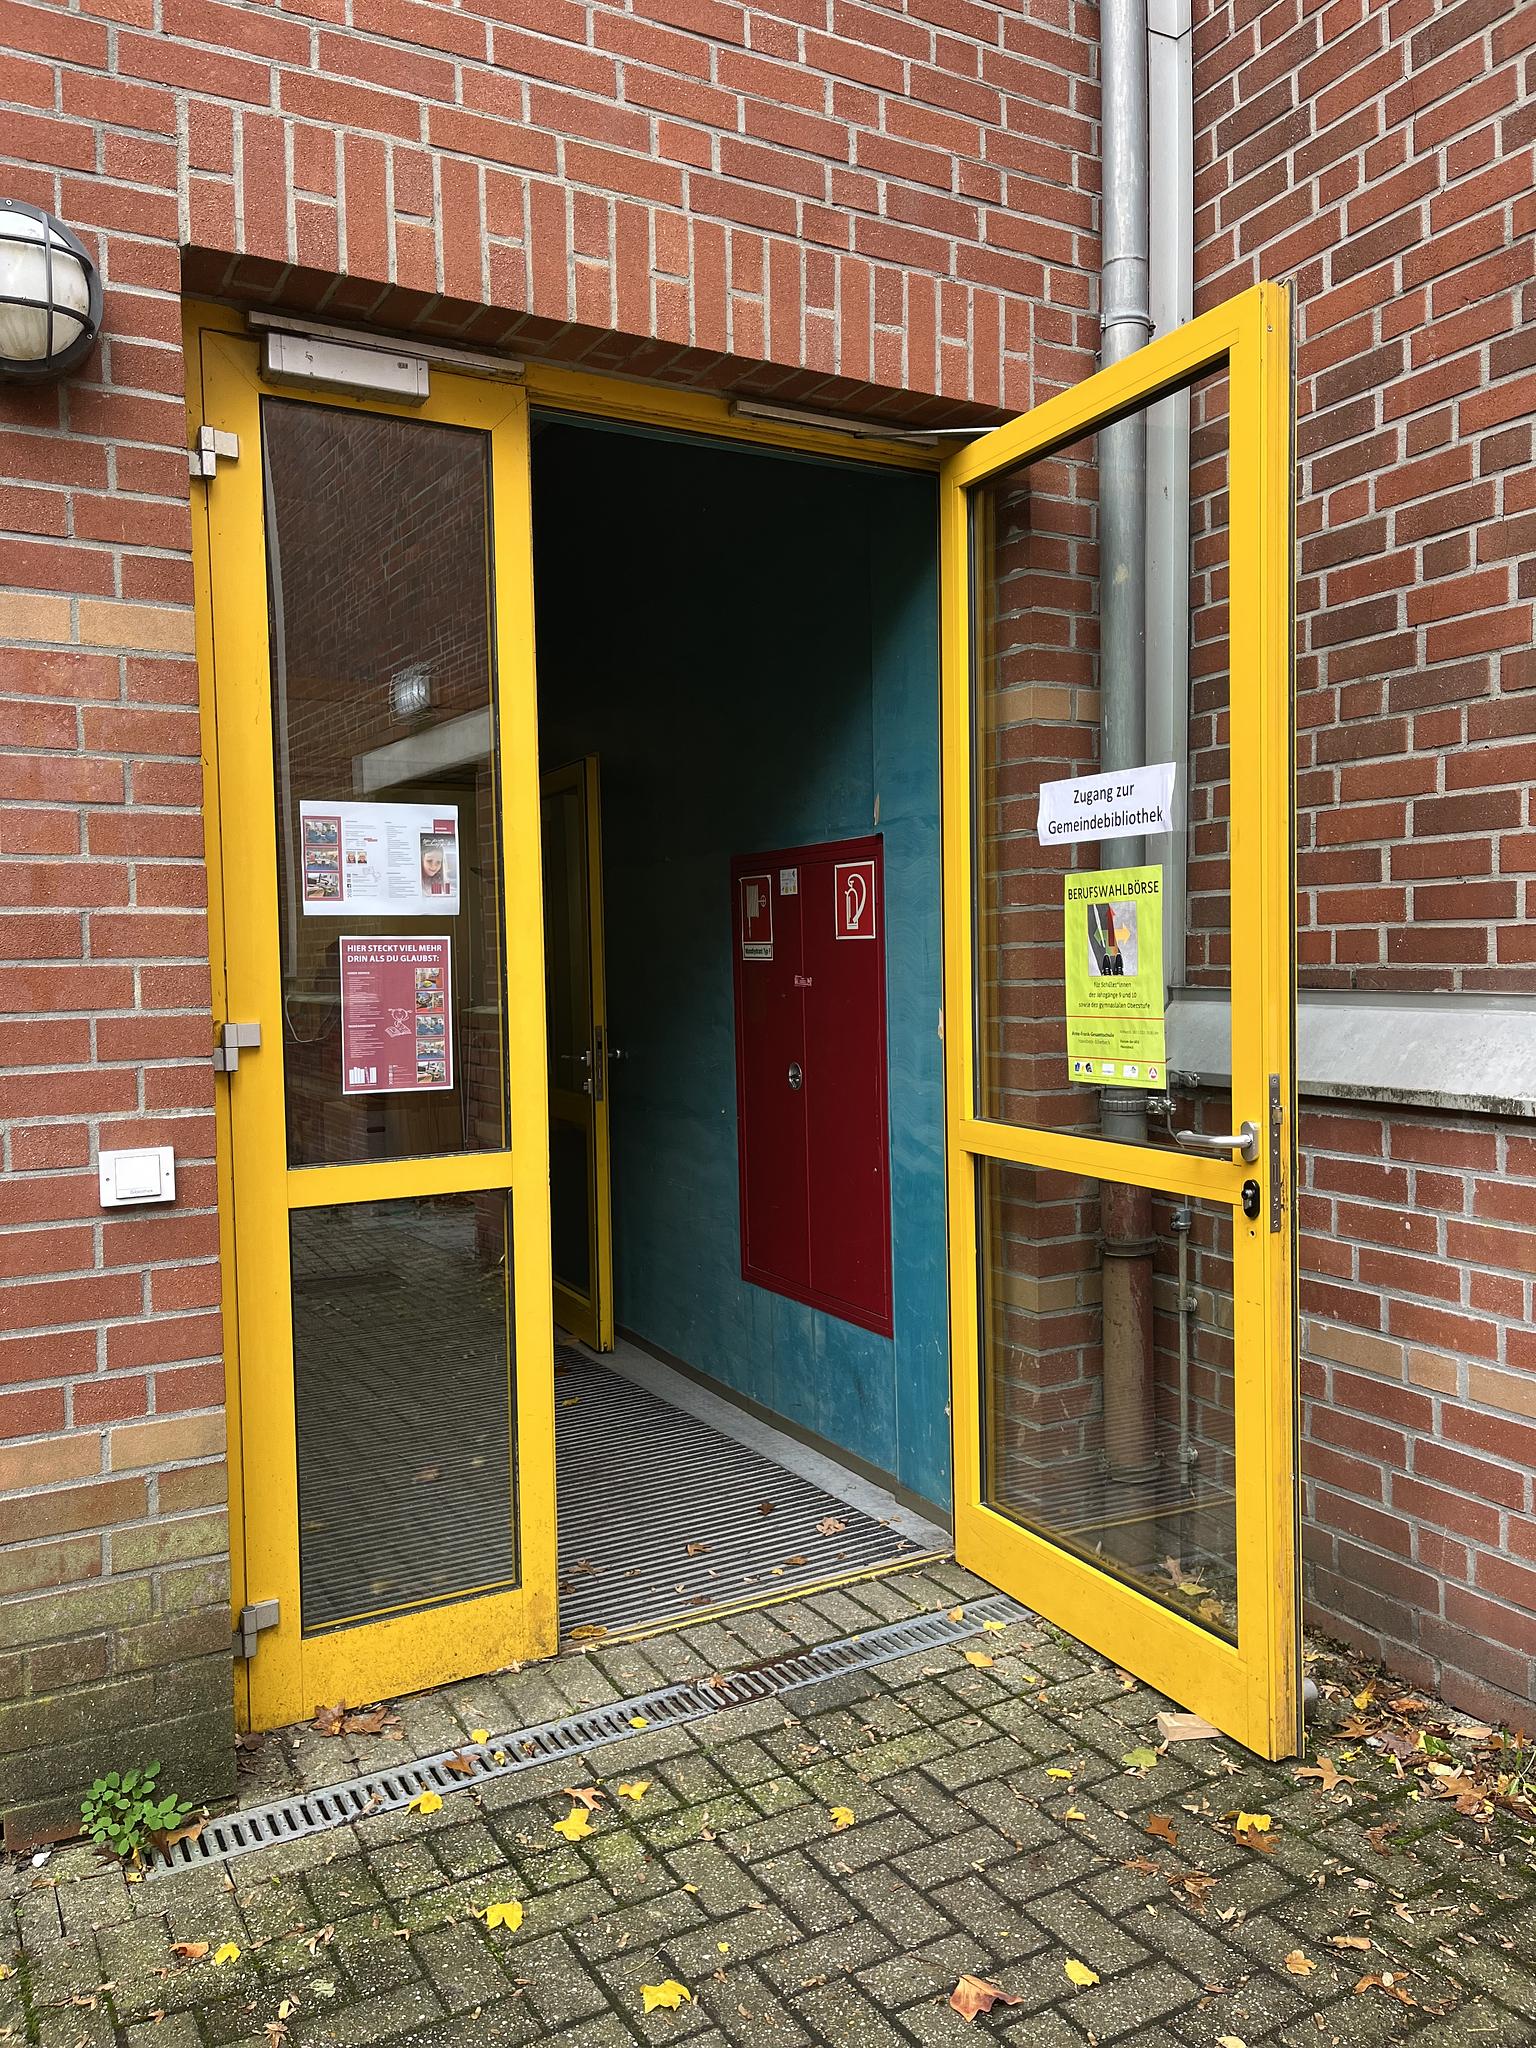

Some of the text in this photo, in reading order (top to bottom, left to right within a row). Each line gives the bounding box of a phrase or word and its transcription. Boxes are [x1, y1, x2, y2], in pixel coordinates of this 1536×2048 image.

[1073, 783, 1135, 805] Zugang zur
[1048, 805, 1163, 835] Gemeindebibliothek
[1068, 879, 1159, 900] BERUFSWAHLBÖRSE
[347, 944, 442, 952] HIER STECKT VIEL MEHR
[347, 954, 440, 963] DRIN ALS DU GLAUBST:
